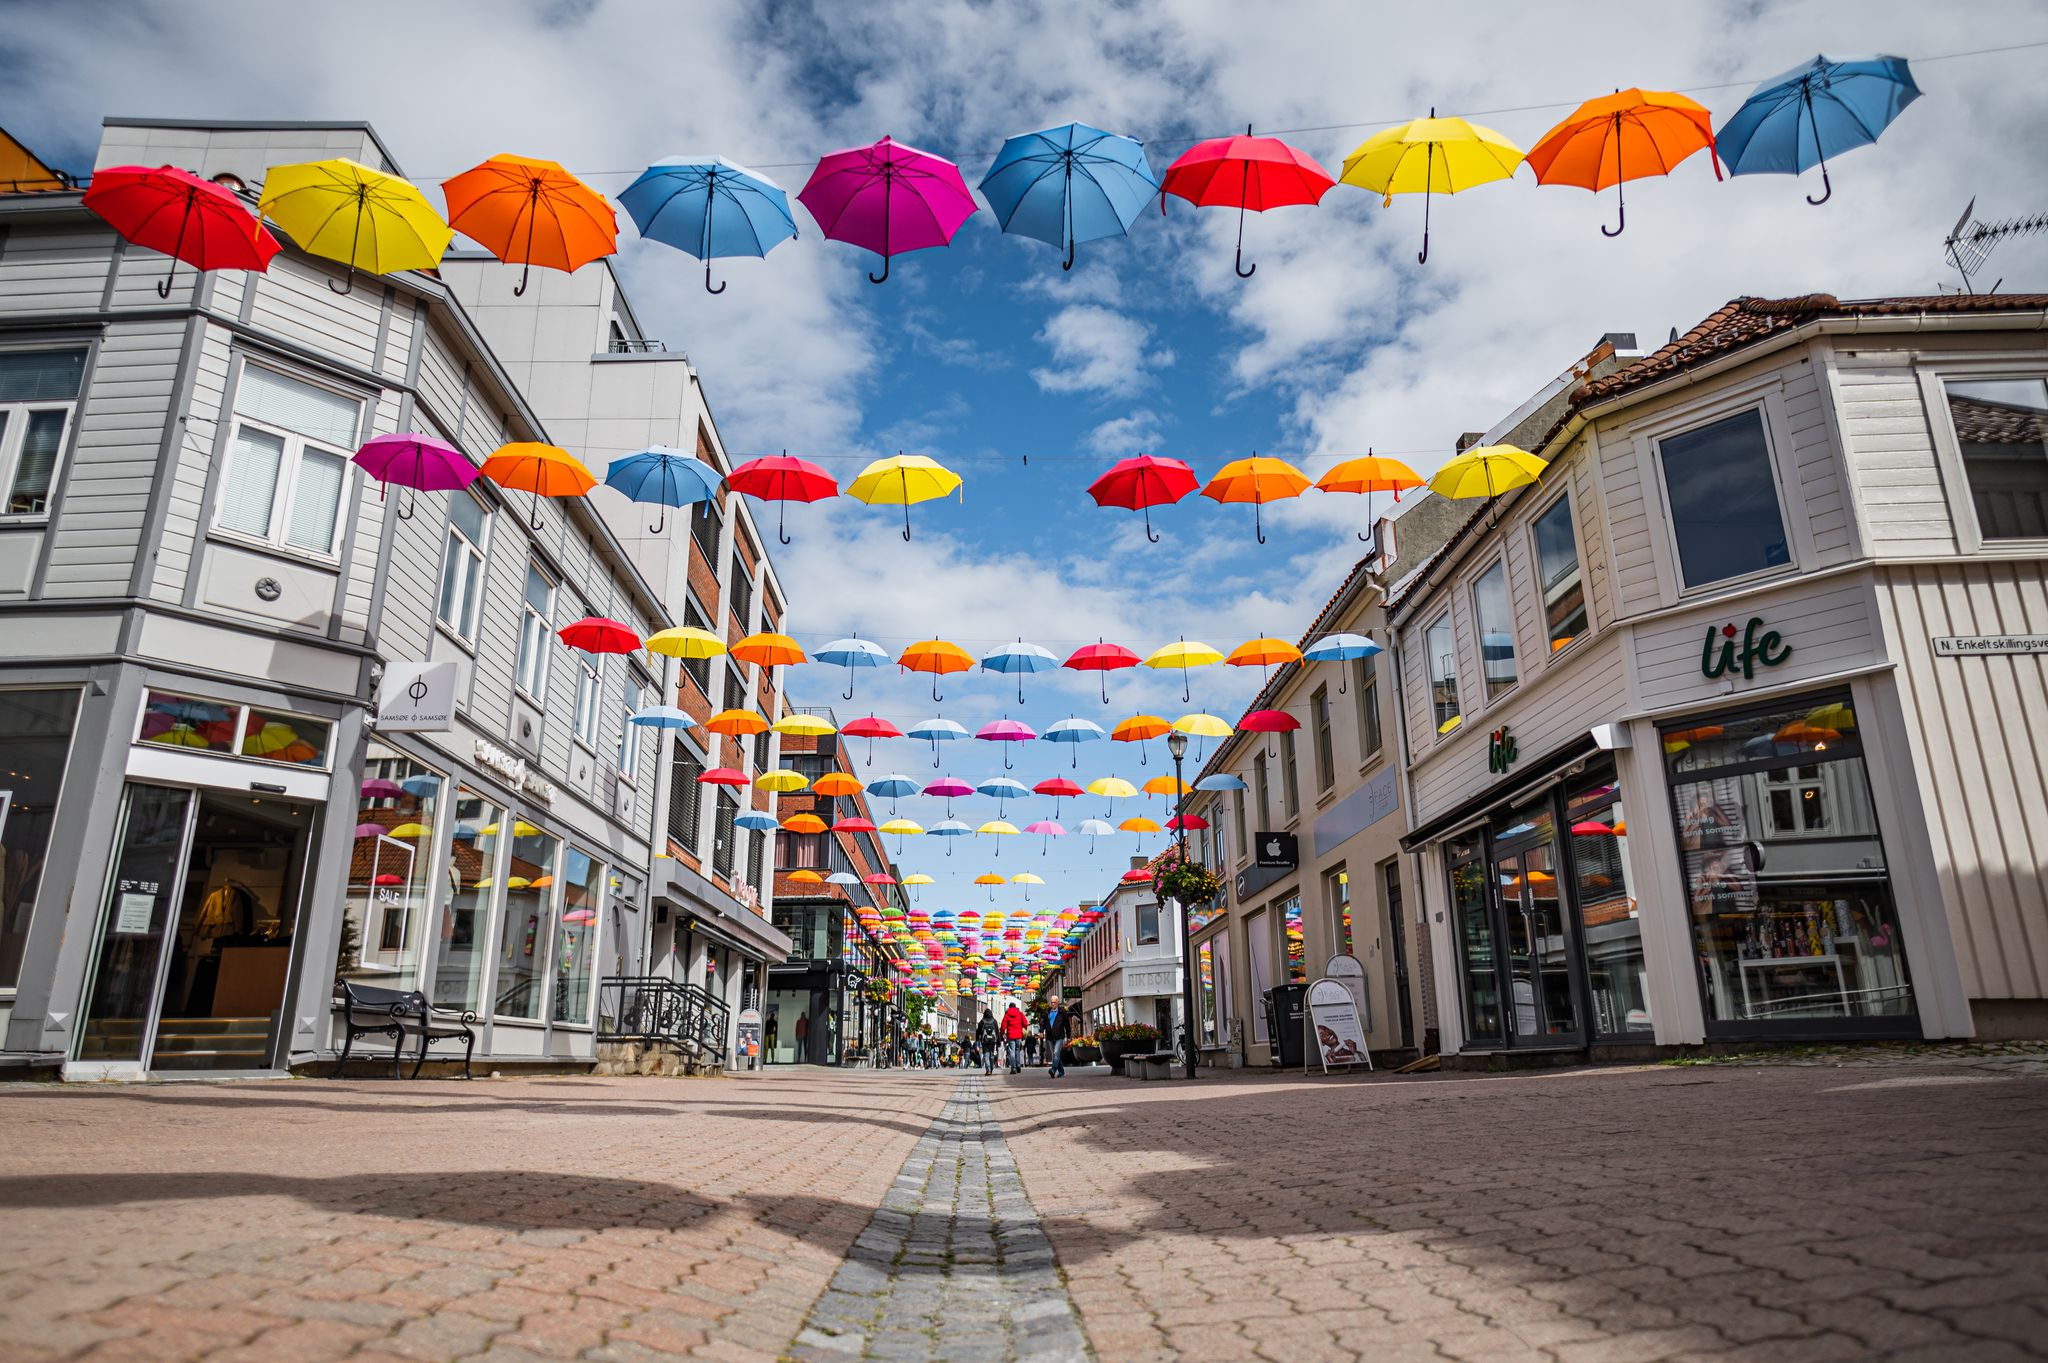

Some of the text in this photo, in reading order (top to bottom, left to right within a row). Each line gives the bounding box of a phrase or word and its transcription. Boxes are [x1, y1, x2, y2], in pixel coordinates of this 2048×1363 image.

[1941, 641, 1953, 651] N.
[380, 713, 409, 721] SAMSØE
[419, 713, 448, 721] SAMSØE
[1706, 824, 1741, 835] sommer
[380, 887, 400, 905] SALE
